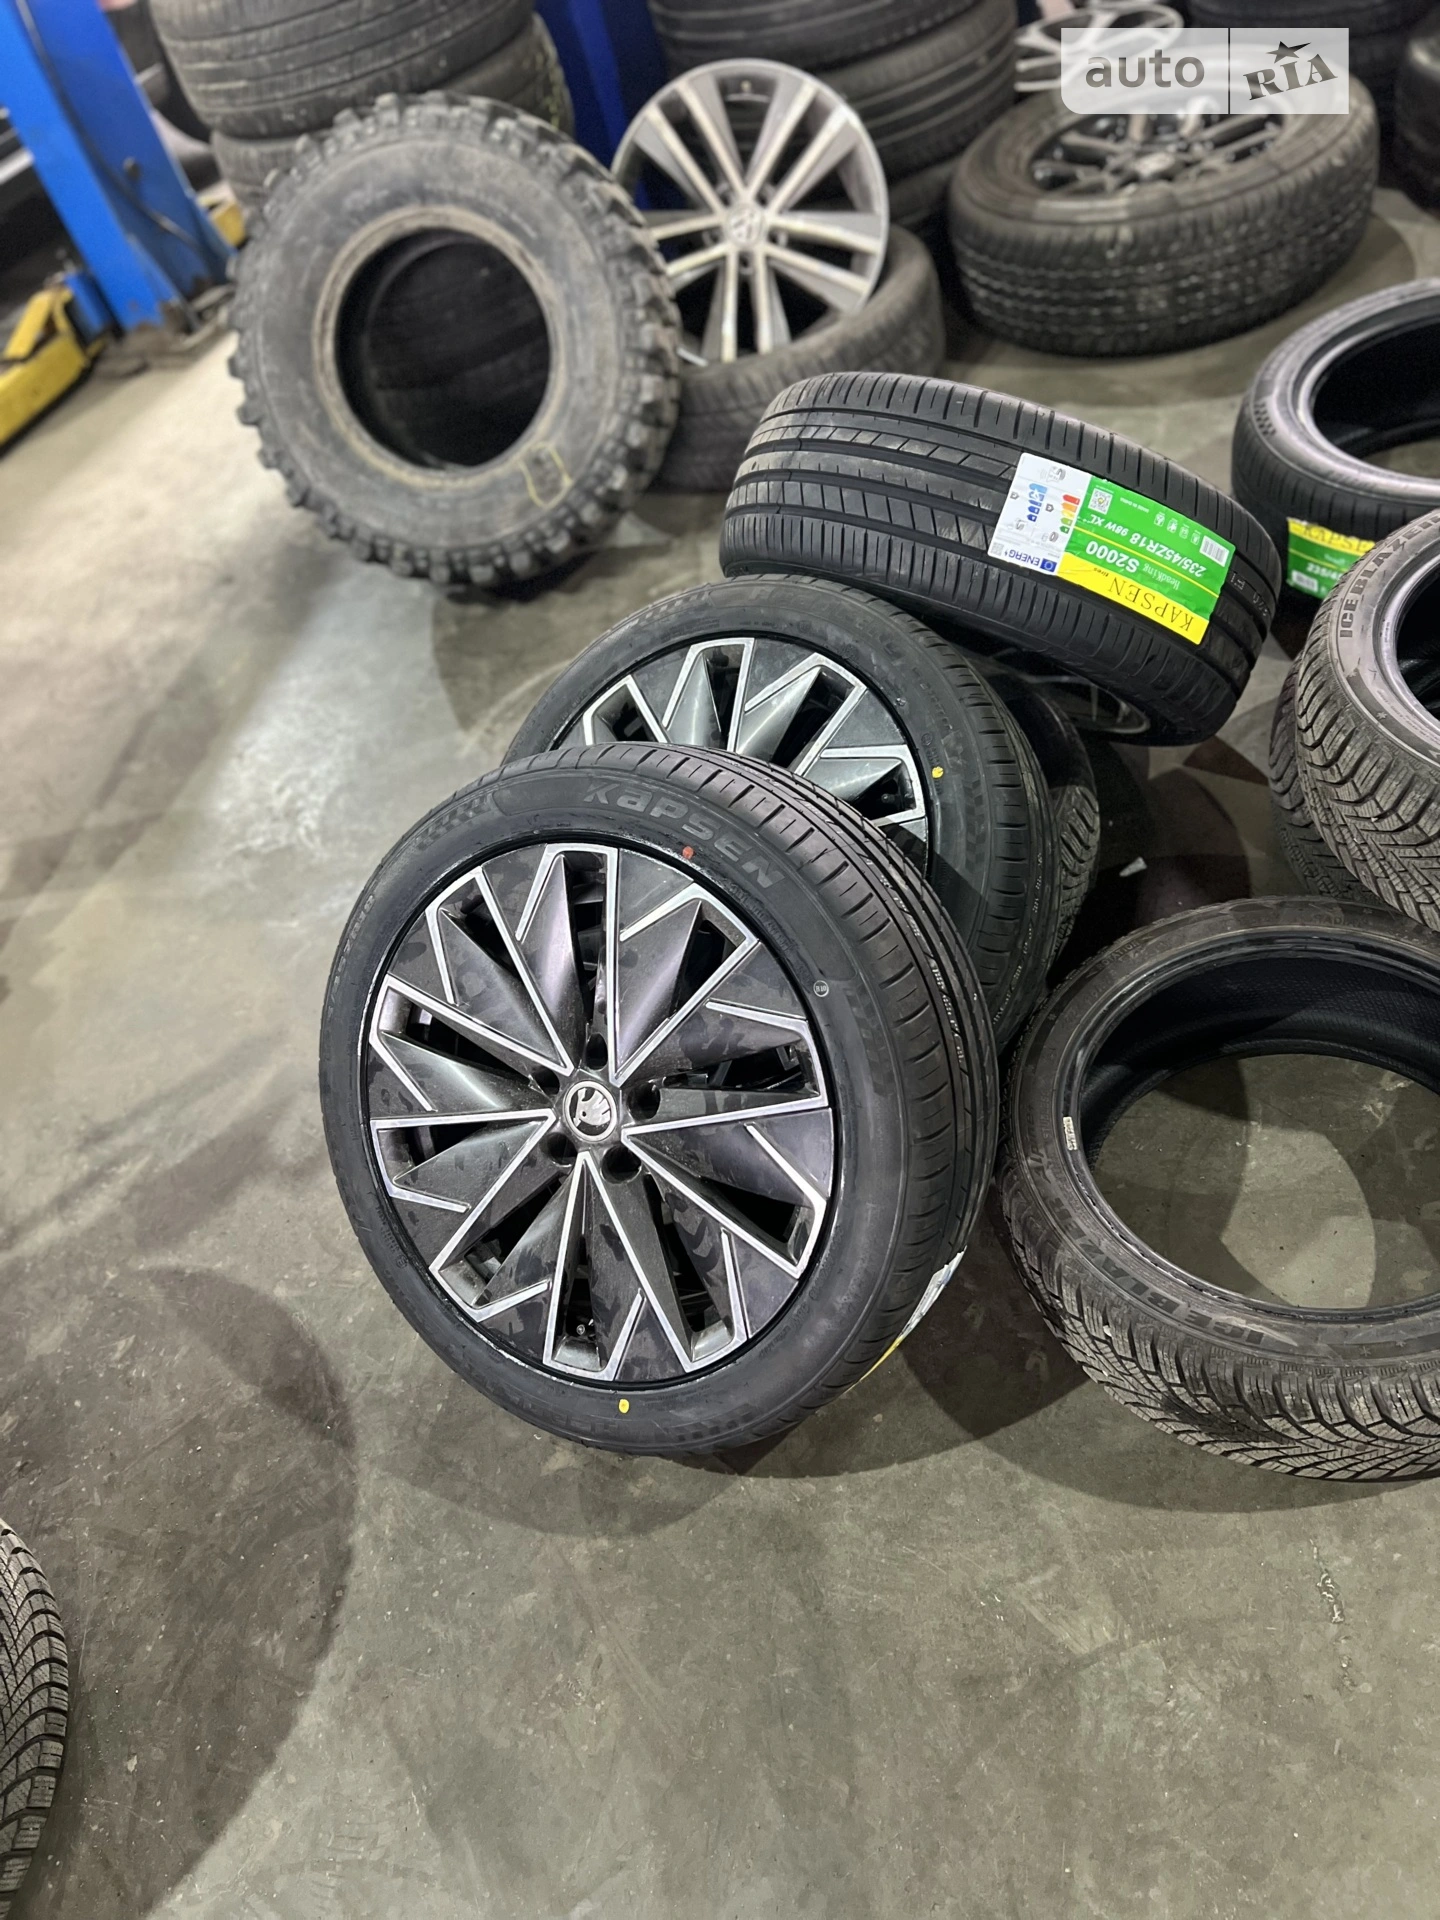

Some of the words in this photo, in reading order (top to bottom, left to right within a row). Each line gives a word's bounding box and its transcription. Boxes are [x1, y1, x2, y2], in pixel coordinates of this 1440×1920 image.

[1090, 514, 1106, 526] XL
[1106, 521, 1129, 537] 98W
[1008, 549, 1041, 566] ENERG
[1085, 540, 1140, 573] S2000
[1130, 532, 1207, 577] 235/45ZR18
[1093, 567, 1110, 577] tires
[1142, 563, 1181, 591] HeadKing
[1108, 577, 1194, 632] KAPSEN
[1339, 599, 1359, 638] ICE
[1050, 1197, 1181, 1316] BLAZER
[1184, 1309, 1264, 1346] ICE
